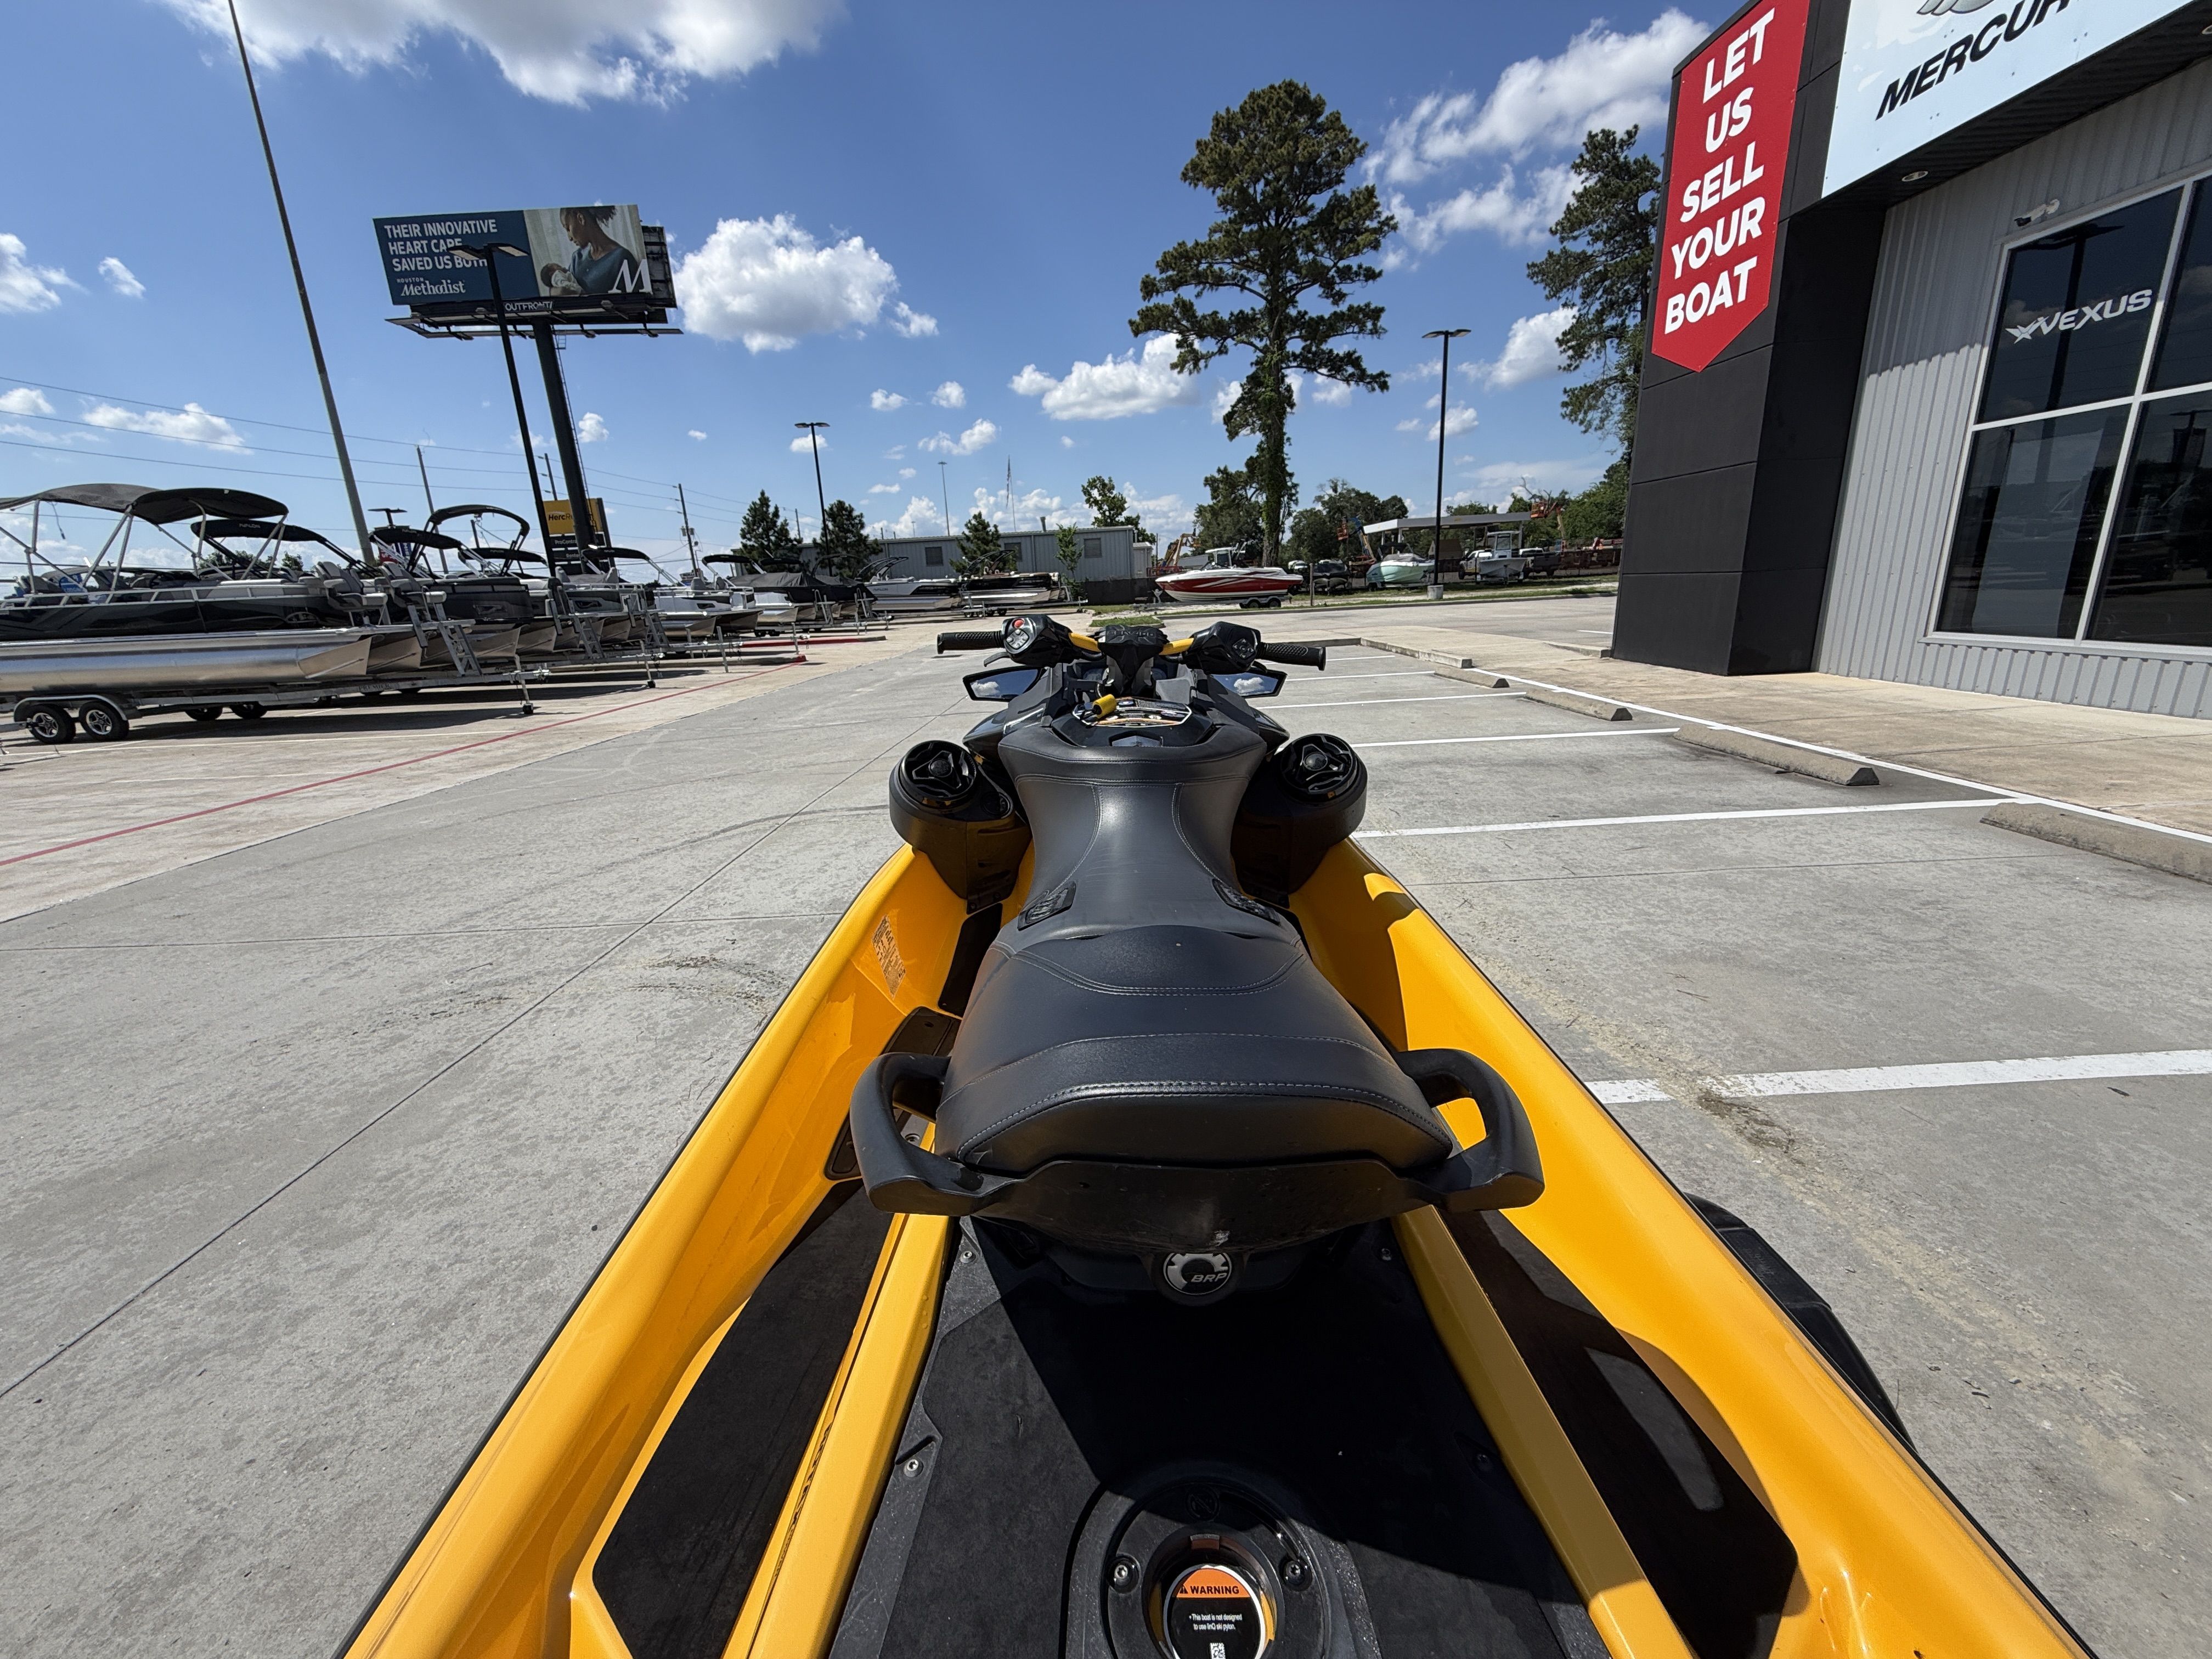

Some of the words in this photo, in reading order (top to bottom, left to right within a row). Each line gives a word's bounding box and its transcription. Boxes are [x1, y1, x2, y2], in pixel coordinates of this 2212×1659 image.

[1702, 7, 1775, 104] LET
[1706, 87, 1754, 154] US
[1680, 141, 1764, 223] SELL
[384, 224, 422, 238] THEIR
[423, 219, 498, 236] INNOVATIVE
[1671, 196, 1765, 280] YOUR
[388, 240, 428, 255] HEART
[392, 257, 433, 272] SAVED
[435, 256, 453, 269] US
[608, 258, 653, 295] M
[400, 280, 466, 296] Methodist
[1664, 256, 1757, 335] BOAT
[2036, 289, 2153, 335] VEXUS
[1190, 1272, 1227, 1282] BRP
[1190, 1585, 1239, 1594] WARNING
[1223, 1613, 1243, 1622] designed
[1223, 1623, 1235, 1632] pylon.
